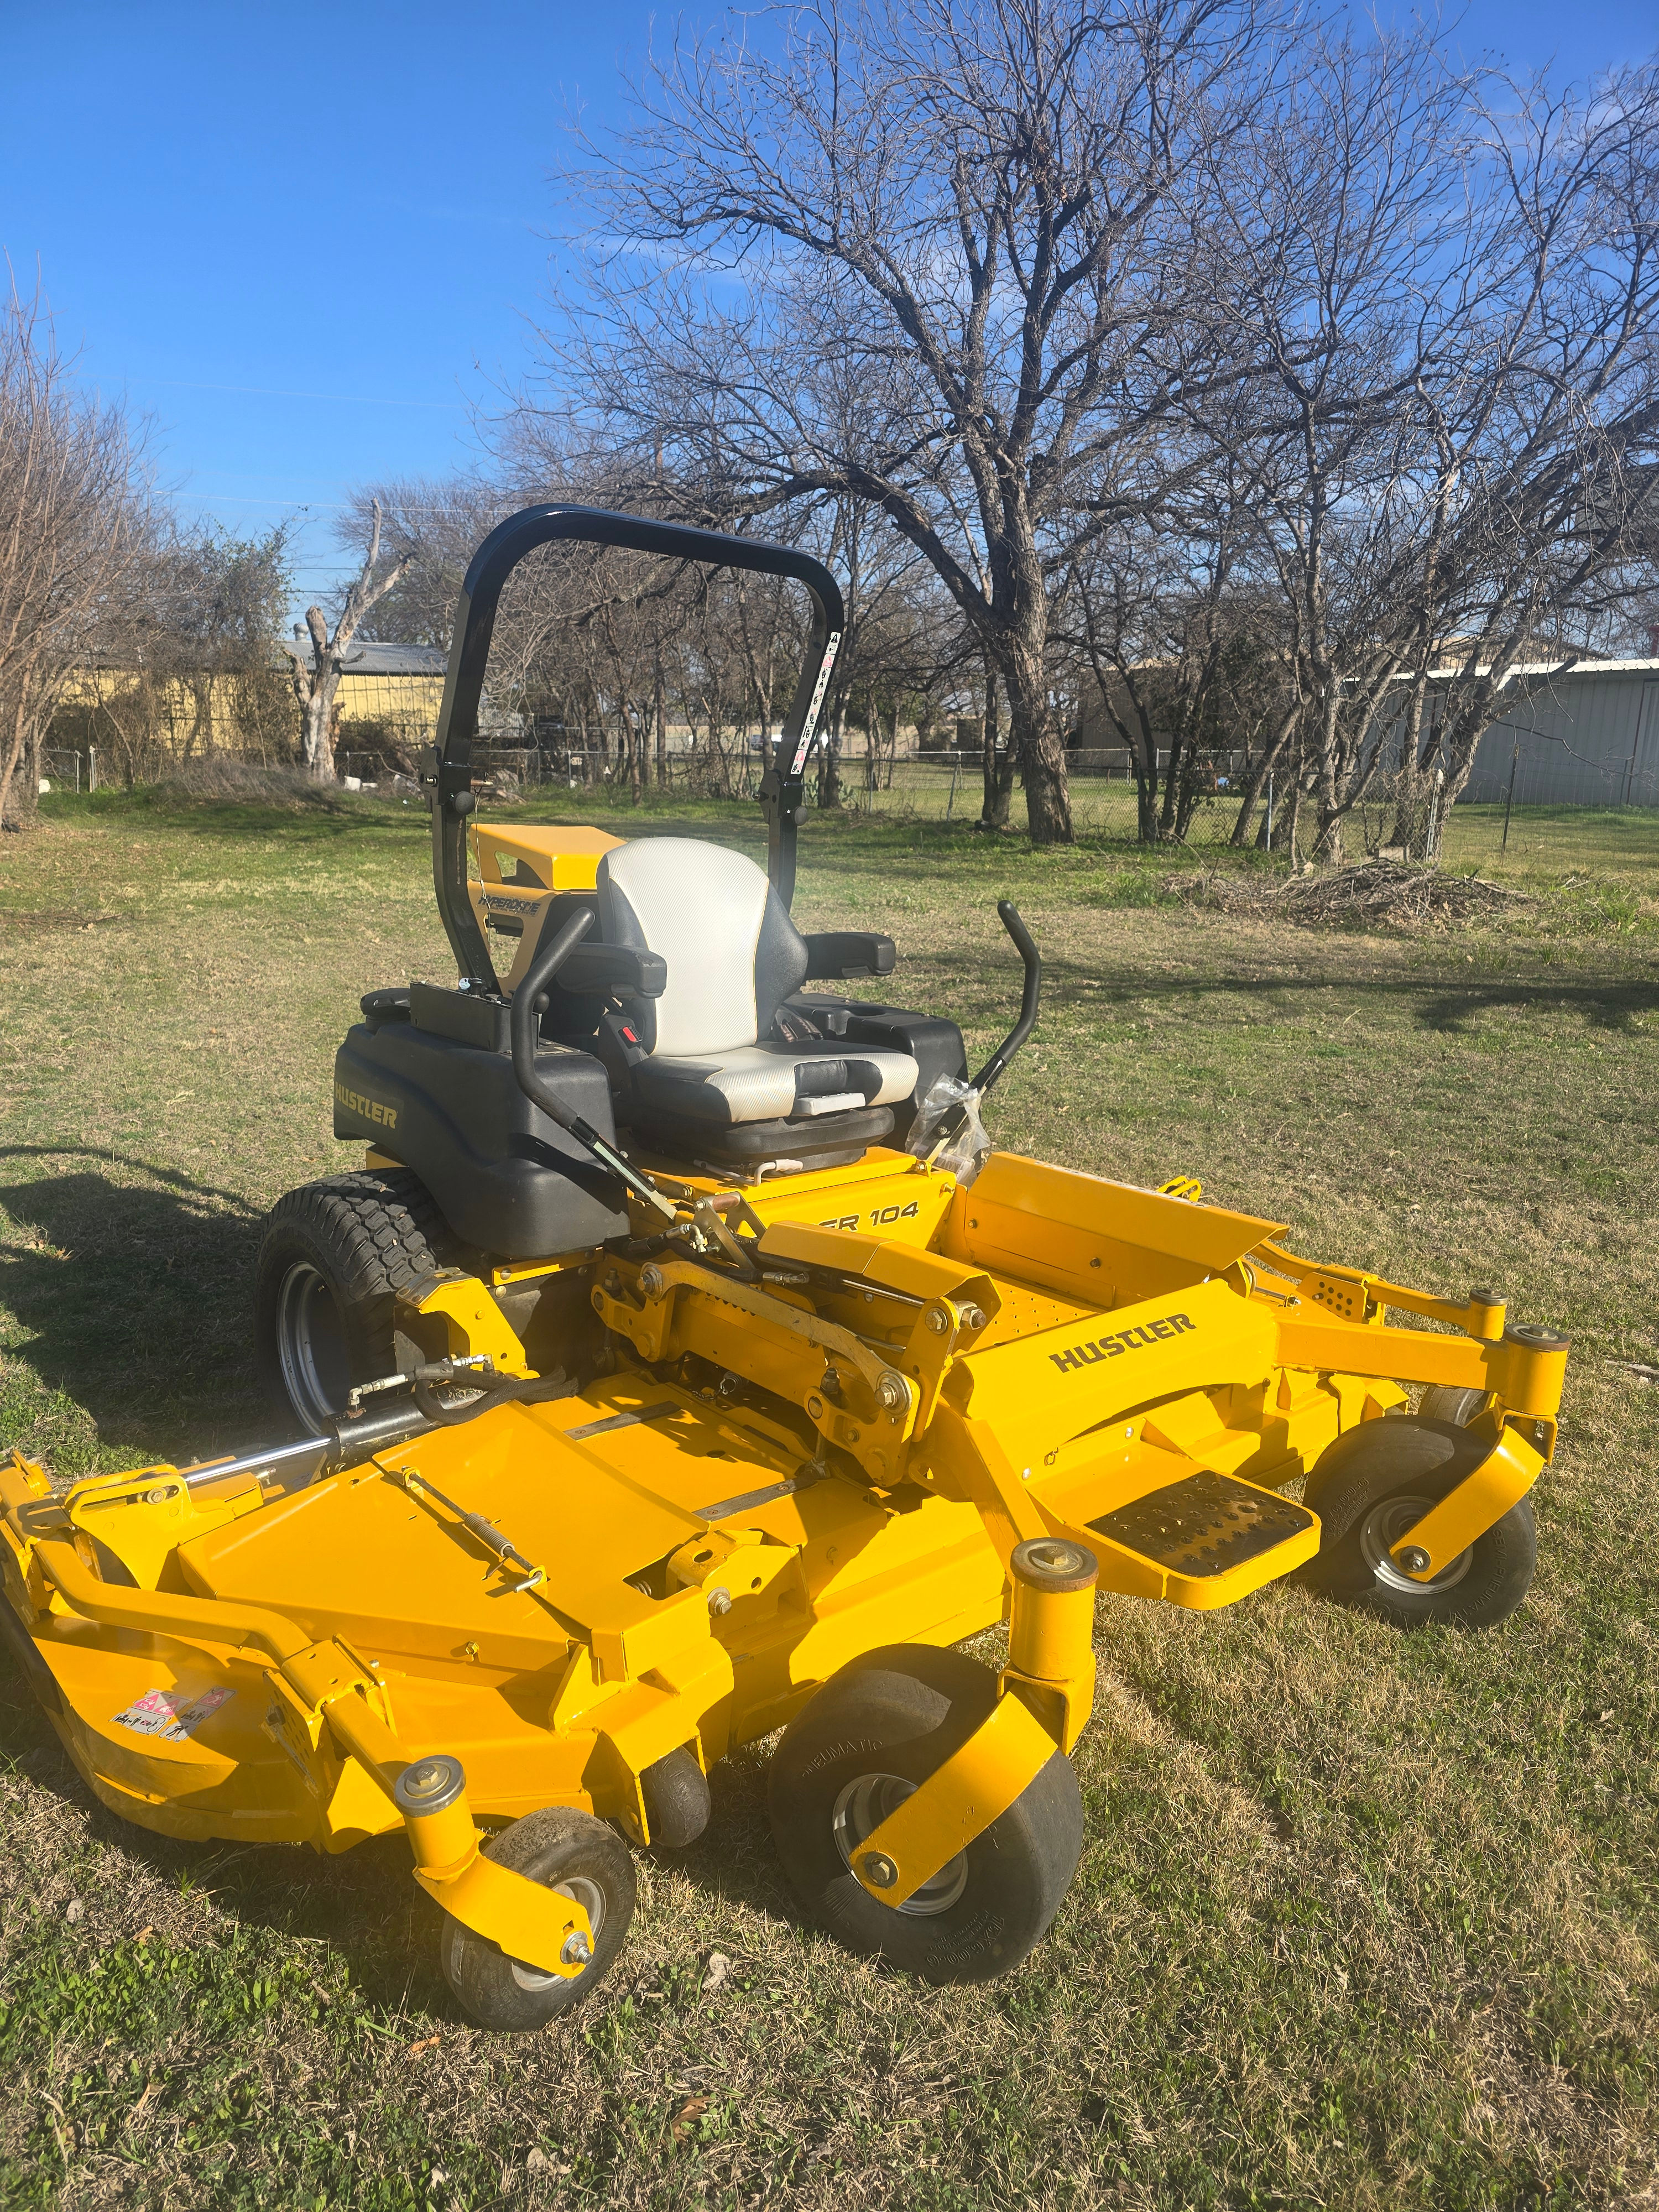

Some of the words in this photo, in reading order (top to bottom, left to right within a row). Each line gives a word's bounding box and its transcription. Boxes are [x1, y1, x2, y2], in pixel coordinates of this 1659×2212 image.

[335, 1081, 397, 1129] HUSTLER
[869, 1201, 919, 1227] 104
[1048, 1313, 1197, 1373] HUSTLER
[1450, 1528, 1507, 1620] SEMI-PNEUMATI
